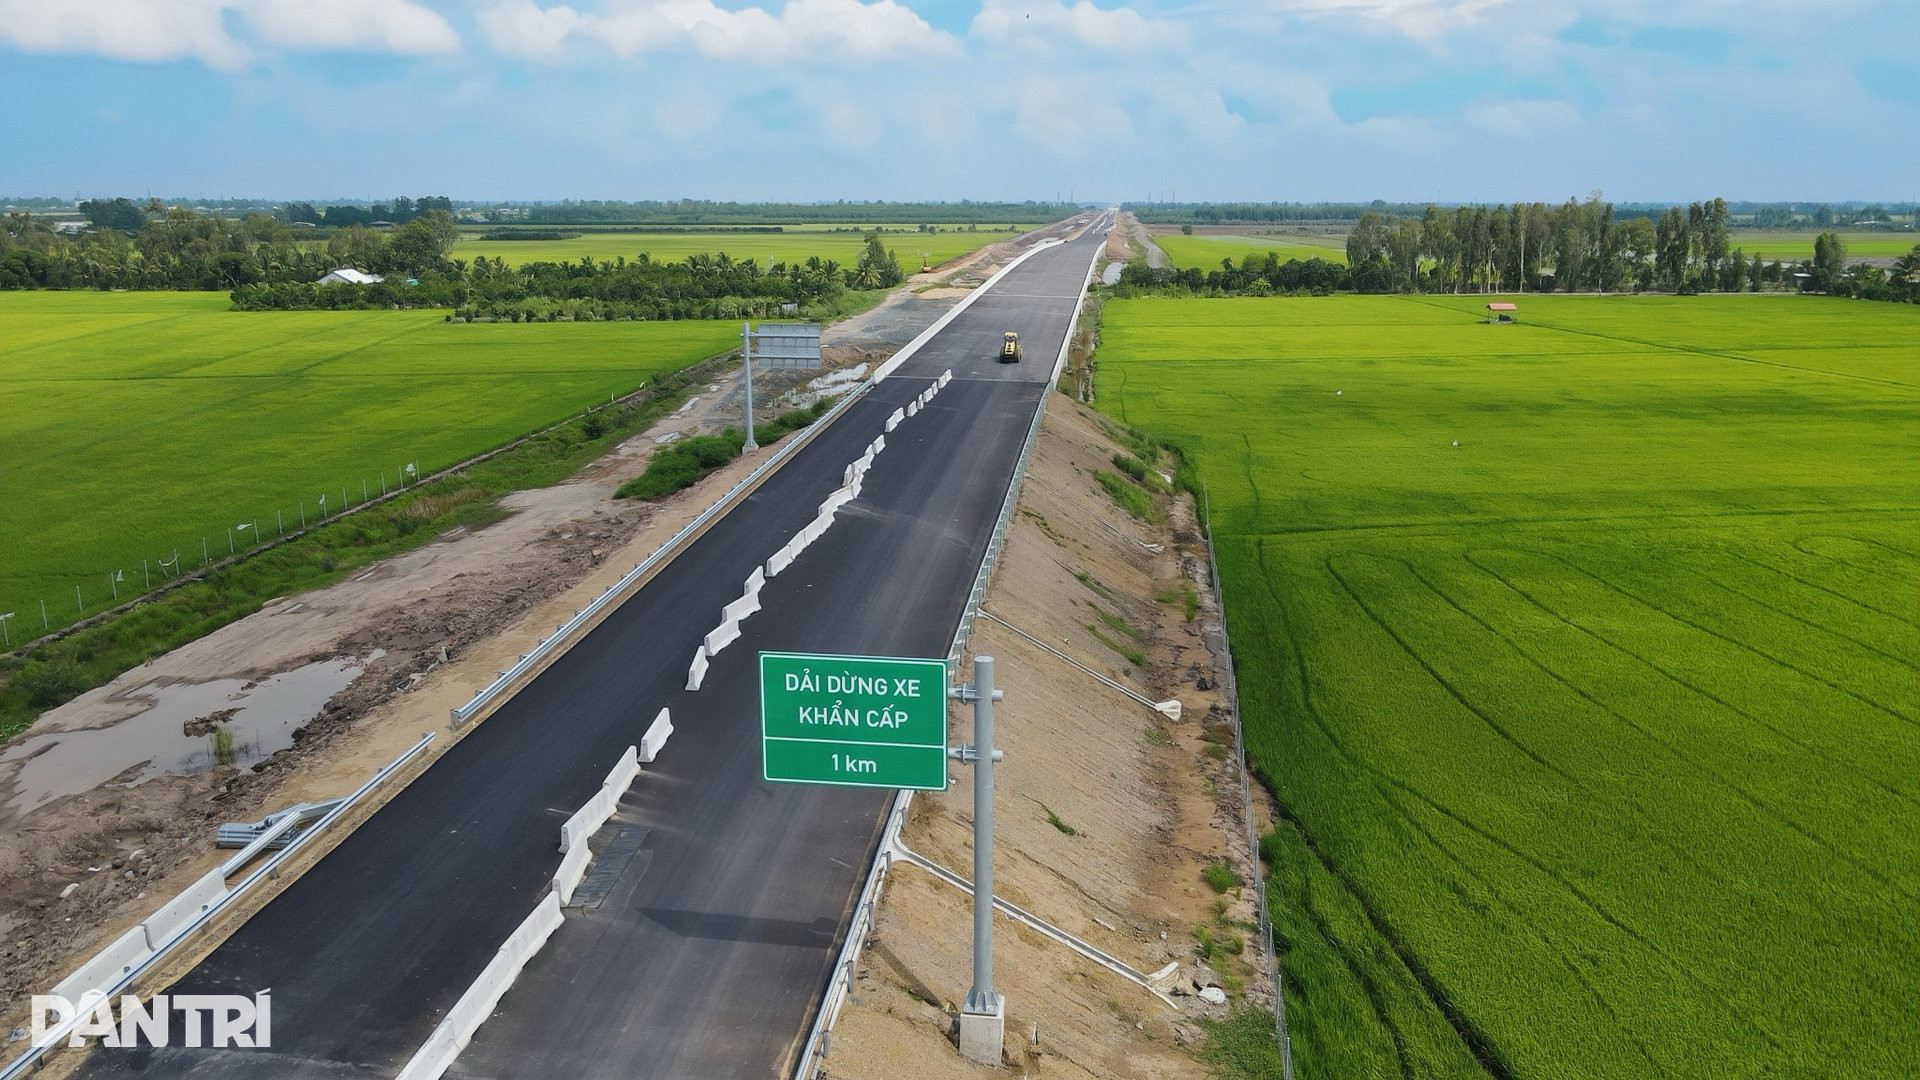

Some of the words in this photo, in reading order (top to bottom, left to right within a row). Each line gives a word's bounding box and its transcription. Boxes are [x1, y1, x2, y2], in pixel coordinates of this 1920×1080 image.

[785, 668, 820, 692] DẢI
[827, 671, 888, 696] DỪNG
[893, 679, 921, 697] XE
[799, 700, 859, 726] KHẨN
[866, 704, 909, 729] CẤP
[831, 754, 839, 771] 1
[845, 755, 877, 773] km
